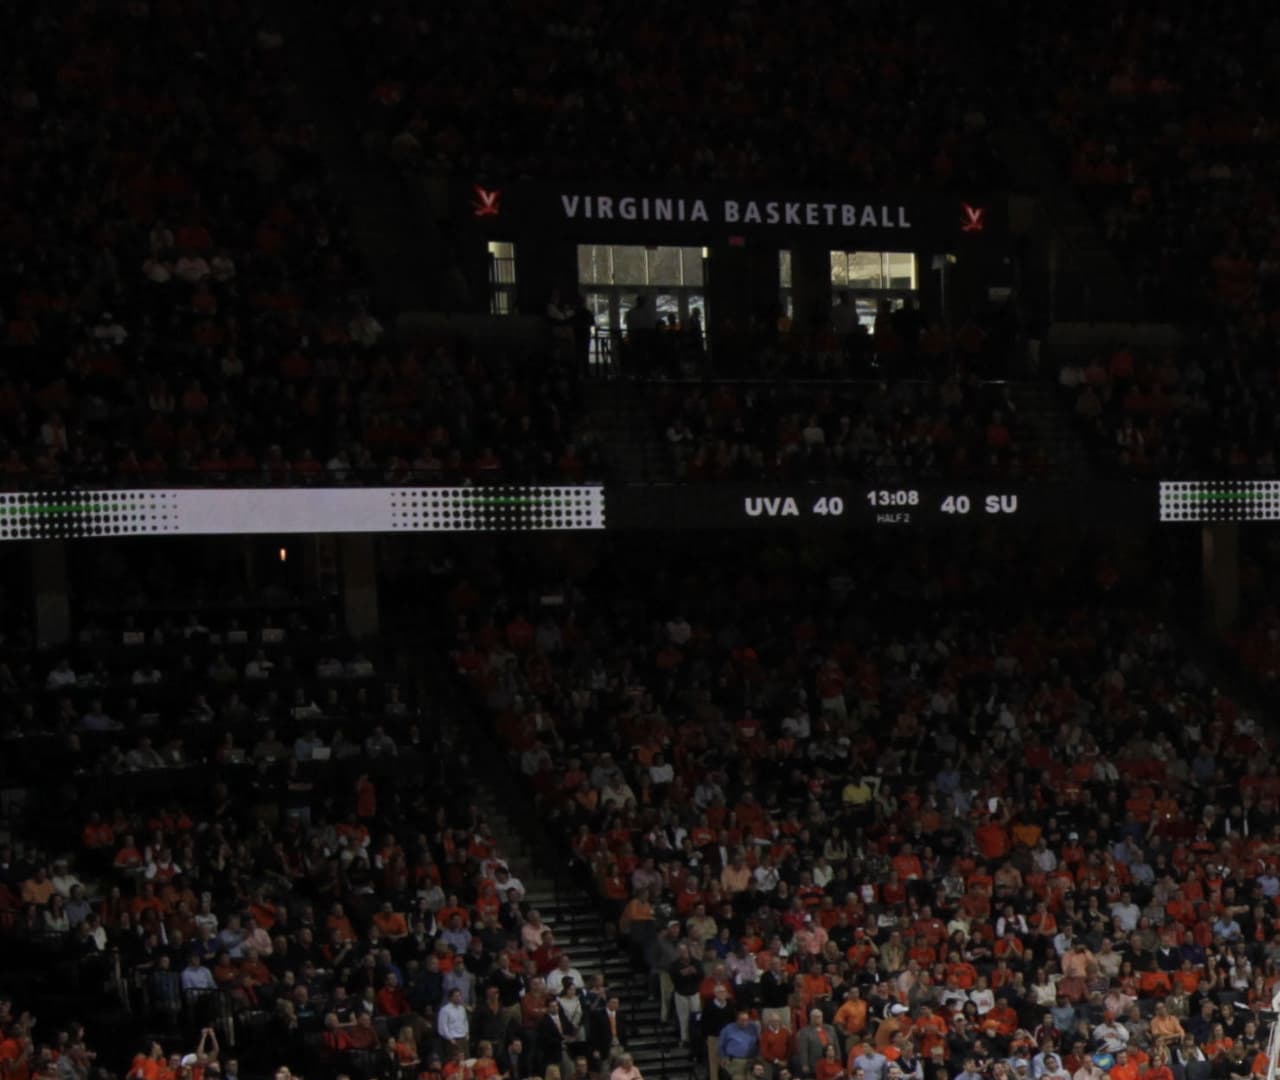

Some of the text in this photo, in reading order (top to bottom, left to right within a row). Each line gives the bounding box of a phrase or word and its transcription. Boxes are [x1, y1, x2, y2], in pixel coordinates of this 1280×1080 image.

[562, 194, 912, 228] VIRGINIA BASKETBALL
[745, 497, 843, 516] UVA 40
[868, 491, 919, 505] 13:08
[941, 495, 1017, 513] 40 SU
[877, 513, 909, 523] HALF 2
